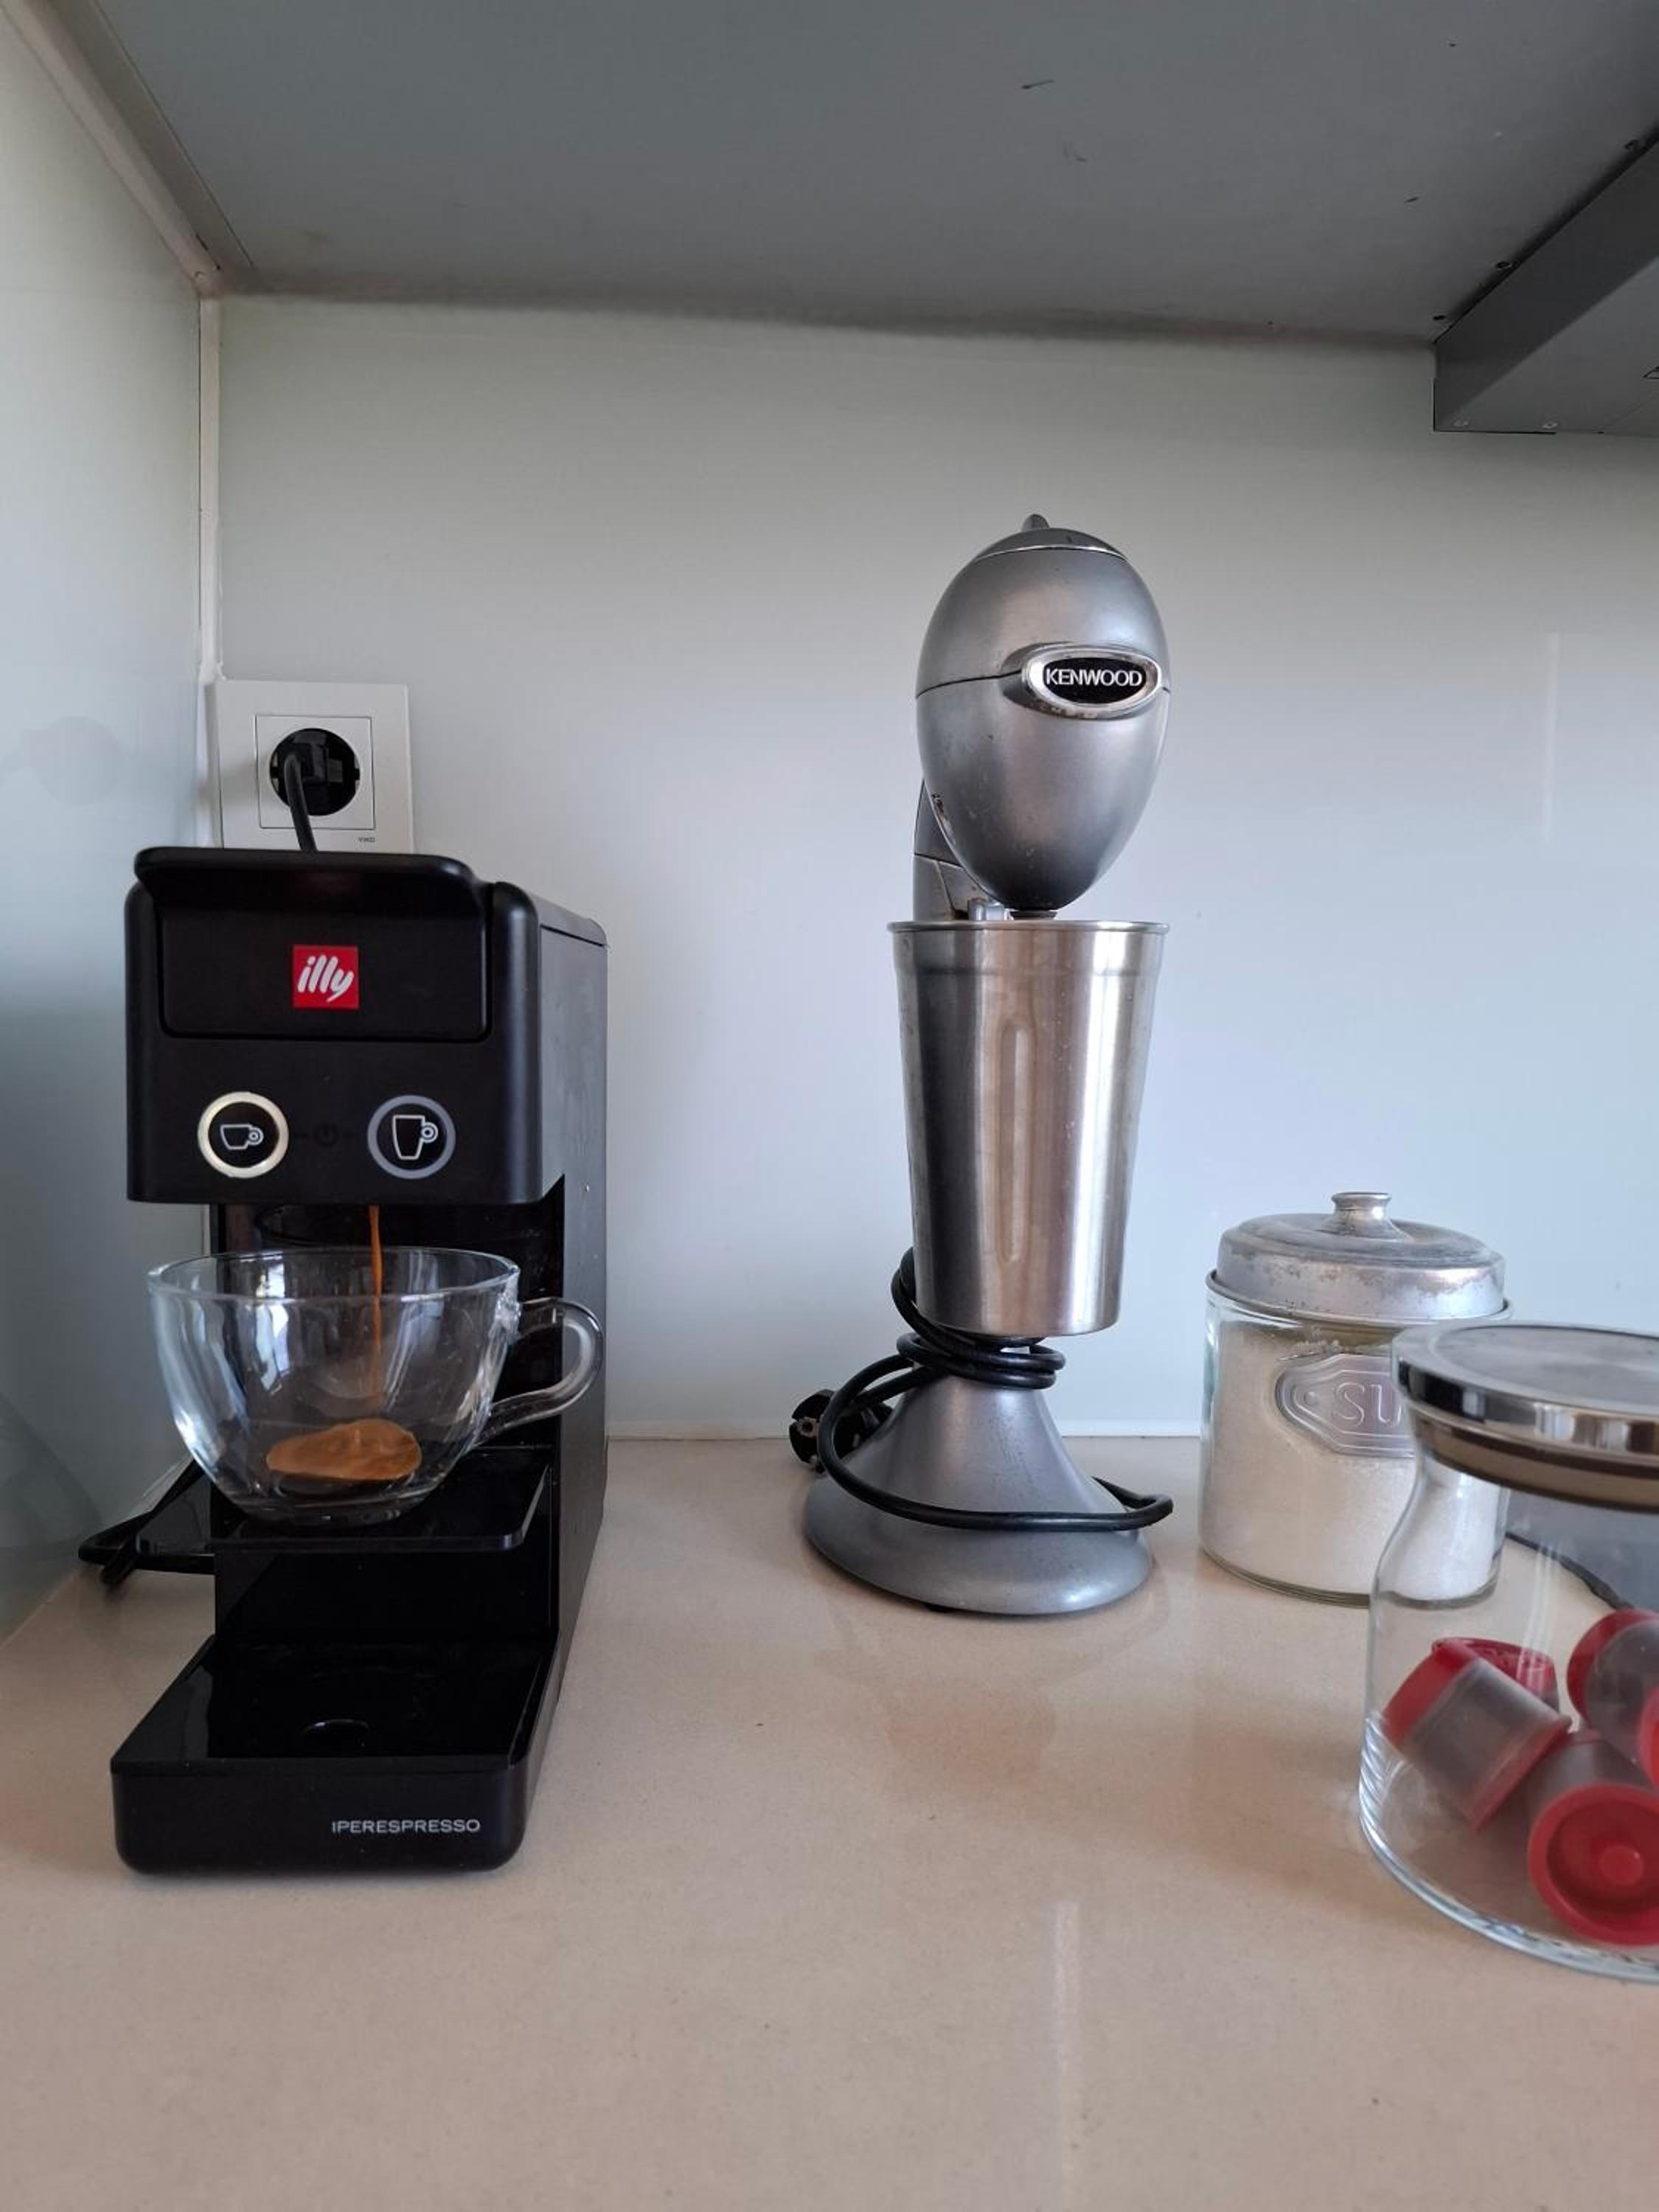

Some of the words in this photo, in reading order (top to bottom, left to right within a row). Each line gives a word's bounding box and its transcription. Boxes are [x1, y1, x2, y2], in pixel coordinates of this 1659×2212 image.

[1046, 668, 1143, 686] KENWOOD
[297, 954, 355, 1003] illy
[332, 1818, 481, 1834] IPERESPRESSO
